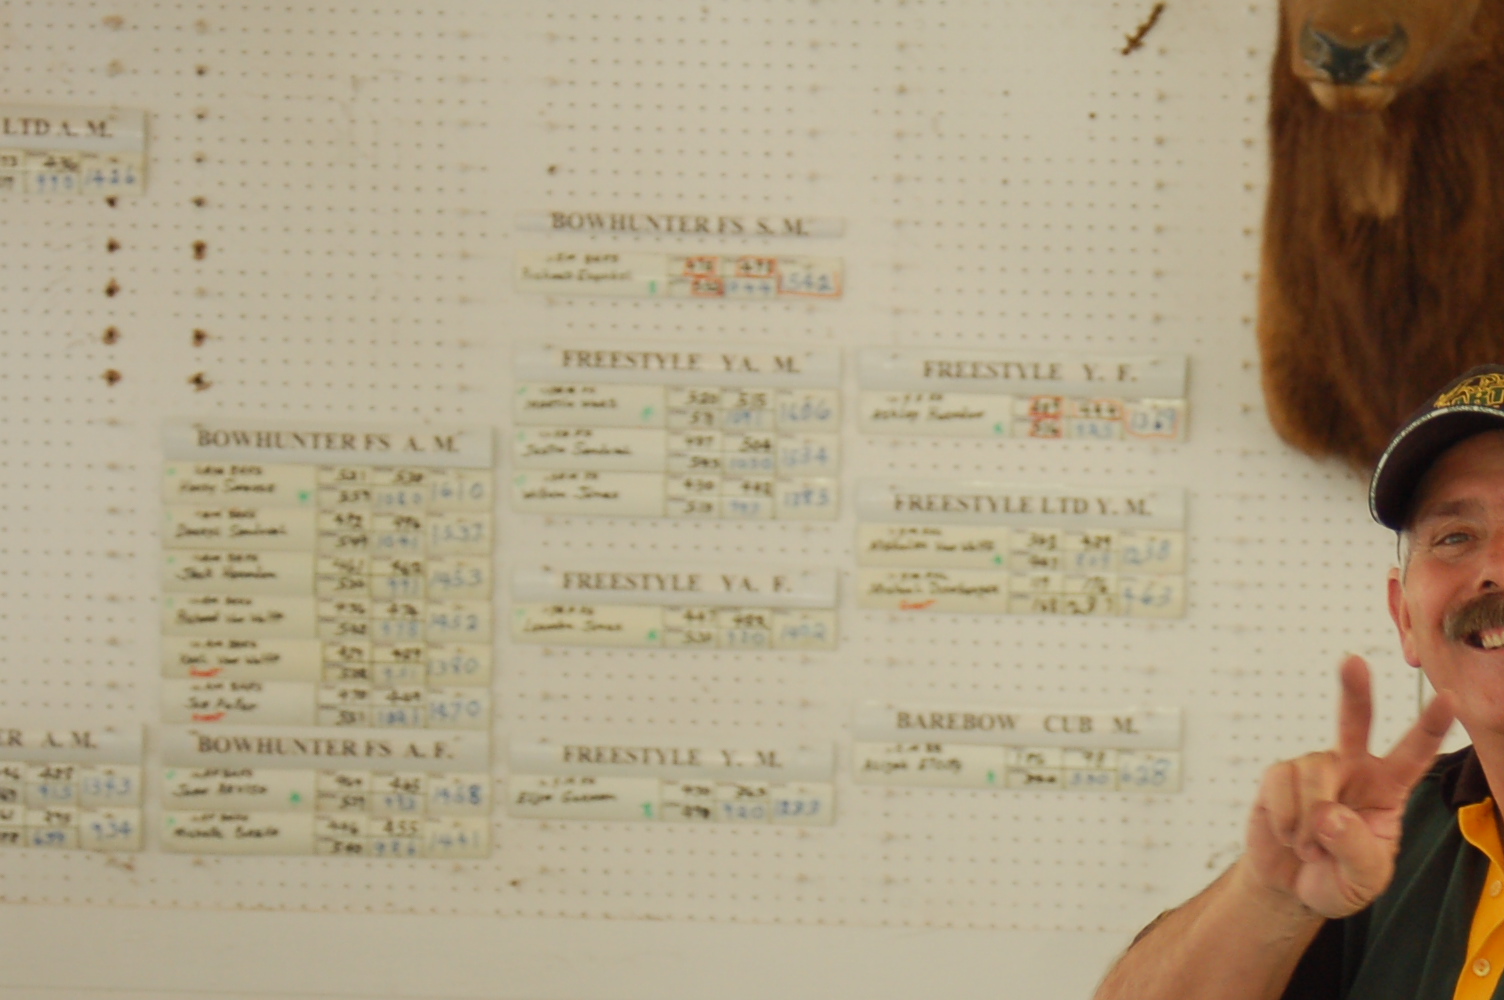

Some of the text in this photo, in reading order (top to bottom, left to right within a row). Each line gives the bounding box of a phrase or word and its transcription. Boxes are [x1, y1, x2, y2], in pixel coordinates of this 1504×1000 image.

[551, 211, 709, 233] BOWHUNTER
[717, 216, 744, 235] FS
[562, 350, 701, 370] FREESTYLE
[923, 359, 1062, 380] FREESTYLE
[1117, 363, 1138, 382] F.
[197, 429, 355, 451] BOWHUNTER
[364, 433, 391, 451] FS
[895, 494, 1032, 513] FREESTYLE
[1041, 496, 1089, 514] LTD
[562, 572, 701, 591] FREESTYLE
[772, 576, 792, 593] F.
[896, 710, 1022, 731] BAREBOW
[1043, 714, 1093, 733] CUB
[198, 735, 357, 757] BOWHUNTER
[366, 739, 393, 757] FS
[434, 741, 455, 759] F.
[562, 745, 701, 766] FREESTYLE
